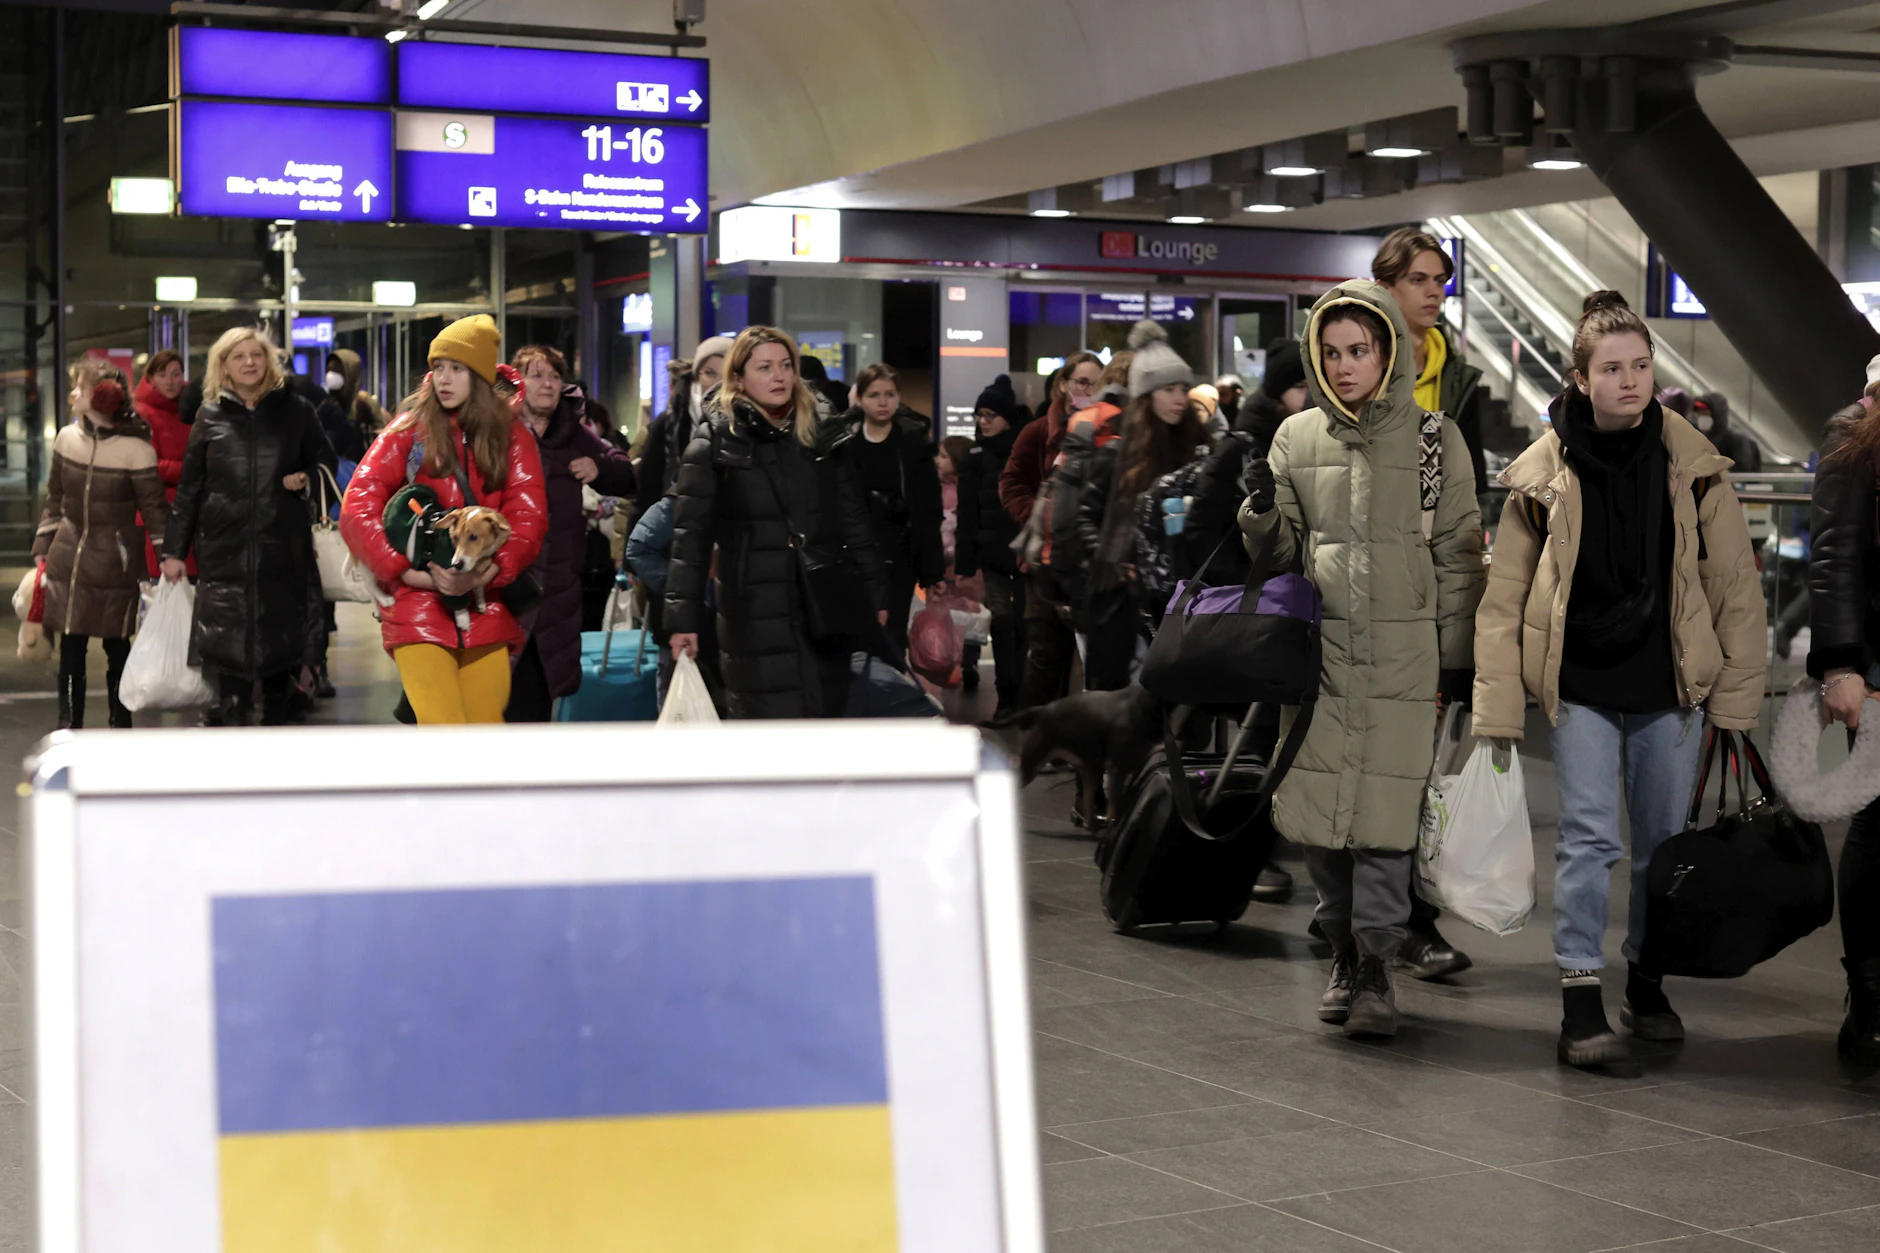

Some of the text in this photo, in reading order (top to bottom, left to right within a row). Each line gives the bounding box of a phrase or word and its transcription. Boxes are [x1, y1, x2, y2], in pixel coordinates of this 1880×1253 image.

[445, 122, 466, 148] S
[582, 125, 664, 164] 11-16
[1138, 235, 1218, 264] Lounge
